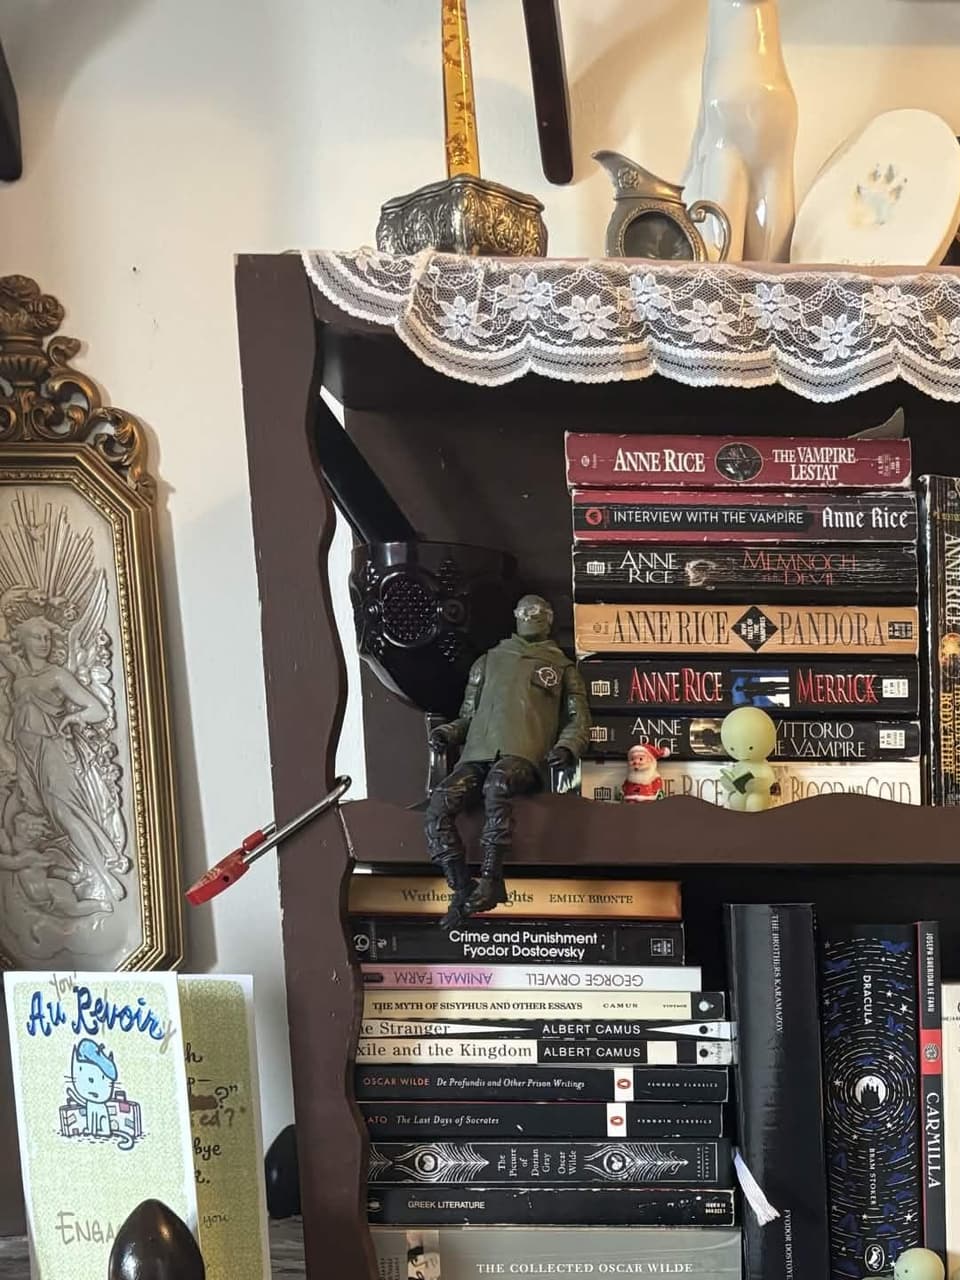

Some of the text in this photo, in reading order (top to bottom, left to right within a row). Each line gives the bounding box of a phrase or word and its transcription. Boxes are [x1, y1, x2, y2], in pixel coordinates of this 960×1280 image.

[613, 448, 705, 473] ANNE RICE
[772, 447, 856, 464] THE VAMPIRE
[790, 464, 839, 481] LESTAT
[613, 511, 804, 524] INTERVIEW WITH THE VAMPIRE
[821, 507, 909, 528] Anne Rice
[620, 550, 676, 569] ANNE
[629, 570, 674, 583] RICE
[611, 611, 670, 645] ANNE
[675, 611, 730, 645] RICE
[778, 613, 886, 646] PANDORA
[629, 667, 722, 702] ANNE RICE
[797, 668, 878, 703] MERRICK
[632, 718, 682, 736] ANNE
[793, 739, 866, 757] VAMPIRE
[449, 930, 598, 945] Crime and Punishment
[463, 944, 585, 960] Fyodor Dostoevsky
[393, 972, 493, 985] ANIMAL FARM
[526, 973, 644, 987] GEORGE ORWELL
[372, 1002, 393, 1010] THE
[395, 1002, 425, 1010] MYTH
[427, 1002, 438, 1010] OF
[440, 1002, 488, 1010] SISYPHUS
[863, 974, 872, 1025] DRACULA
[27, 986, 166, 1040] Au Revoir
[542, 1023, 641, 1035] ALBERT CAMUS
[543, 1046, 641, 1058] ALBERT CAMUS
[400, 1078, 430, 1086] WILDE
[437, 1078, 585, 1089] De Profundis and Other Prison Writings
[926, 1091, 942, 1189] CARMILLA
[408, 1200, 485, 1209] GREEK LITERATURE
[476, 1263, 694, 1274] THE COLLECTED OSCAR WILDE
